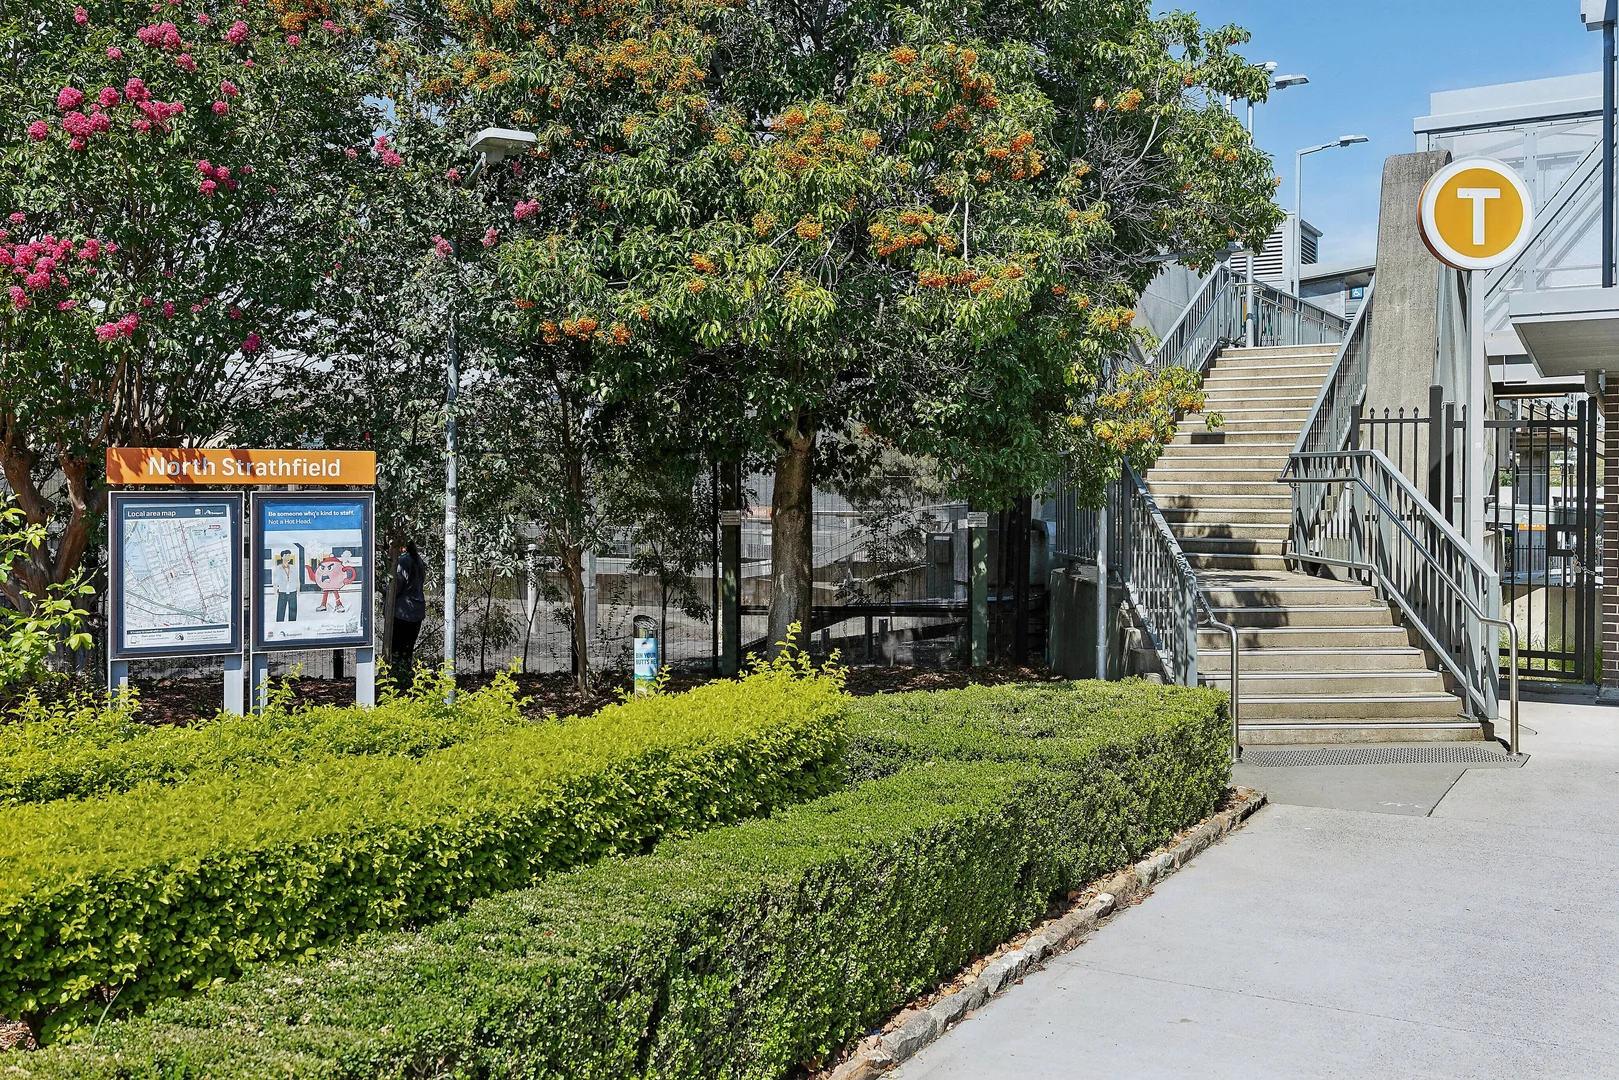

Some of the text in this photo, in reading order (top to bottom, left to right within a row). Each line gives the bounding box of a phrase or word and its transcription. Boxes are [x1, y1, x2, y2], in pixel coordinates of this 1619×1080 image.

[1457, 188, 1501, 245] T
[149, 456, 341, 477] North Strathfield
[161, 510, 176, 518] map
